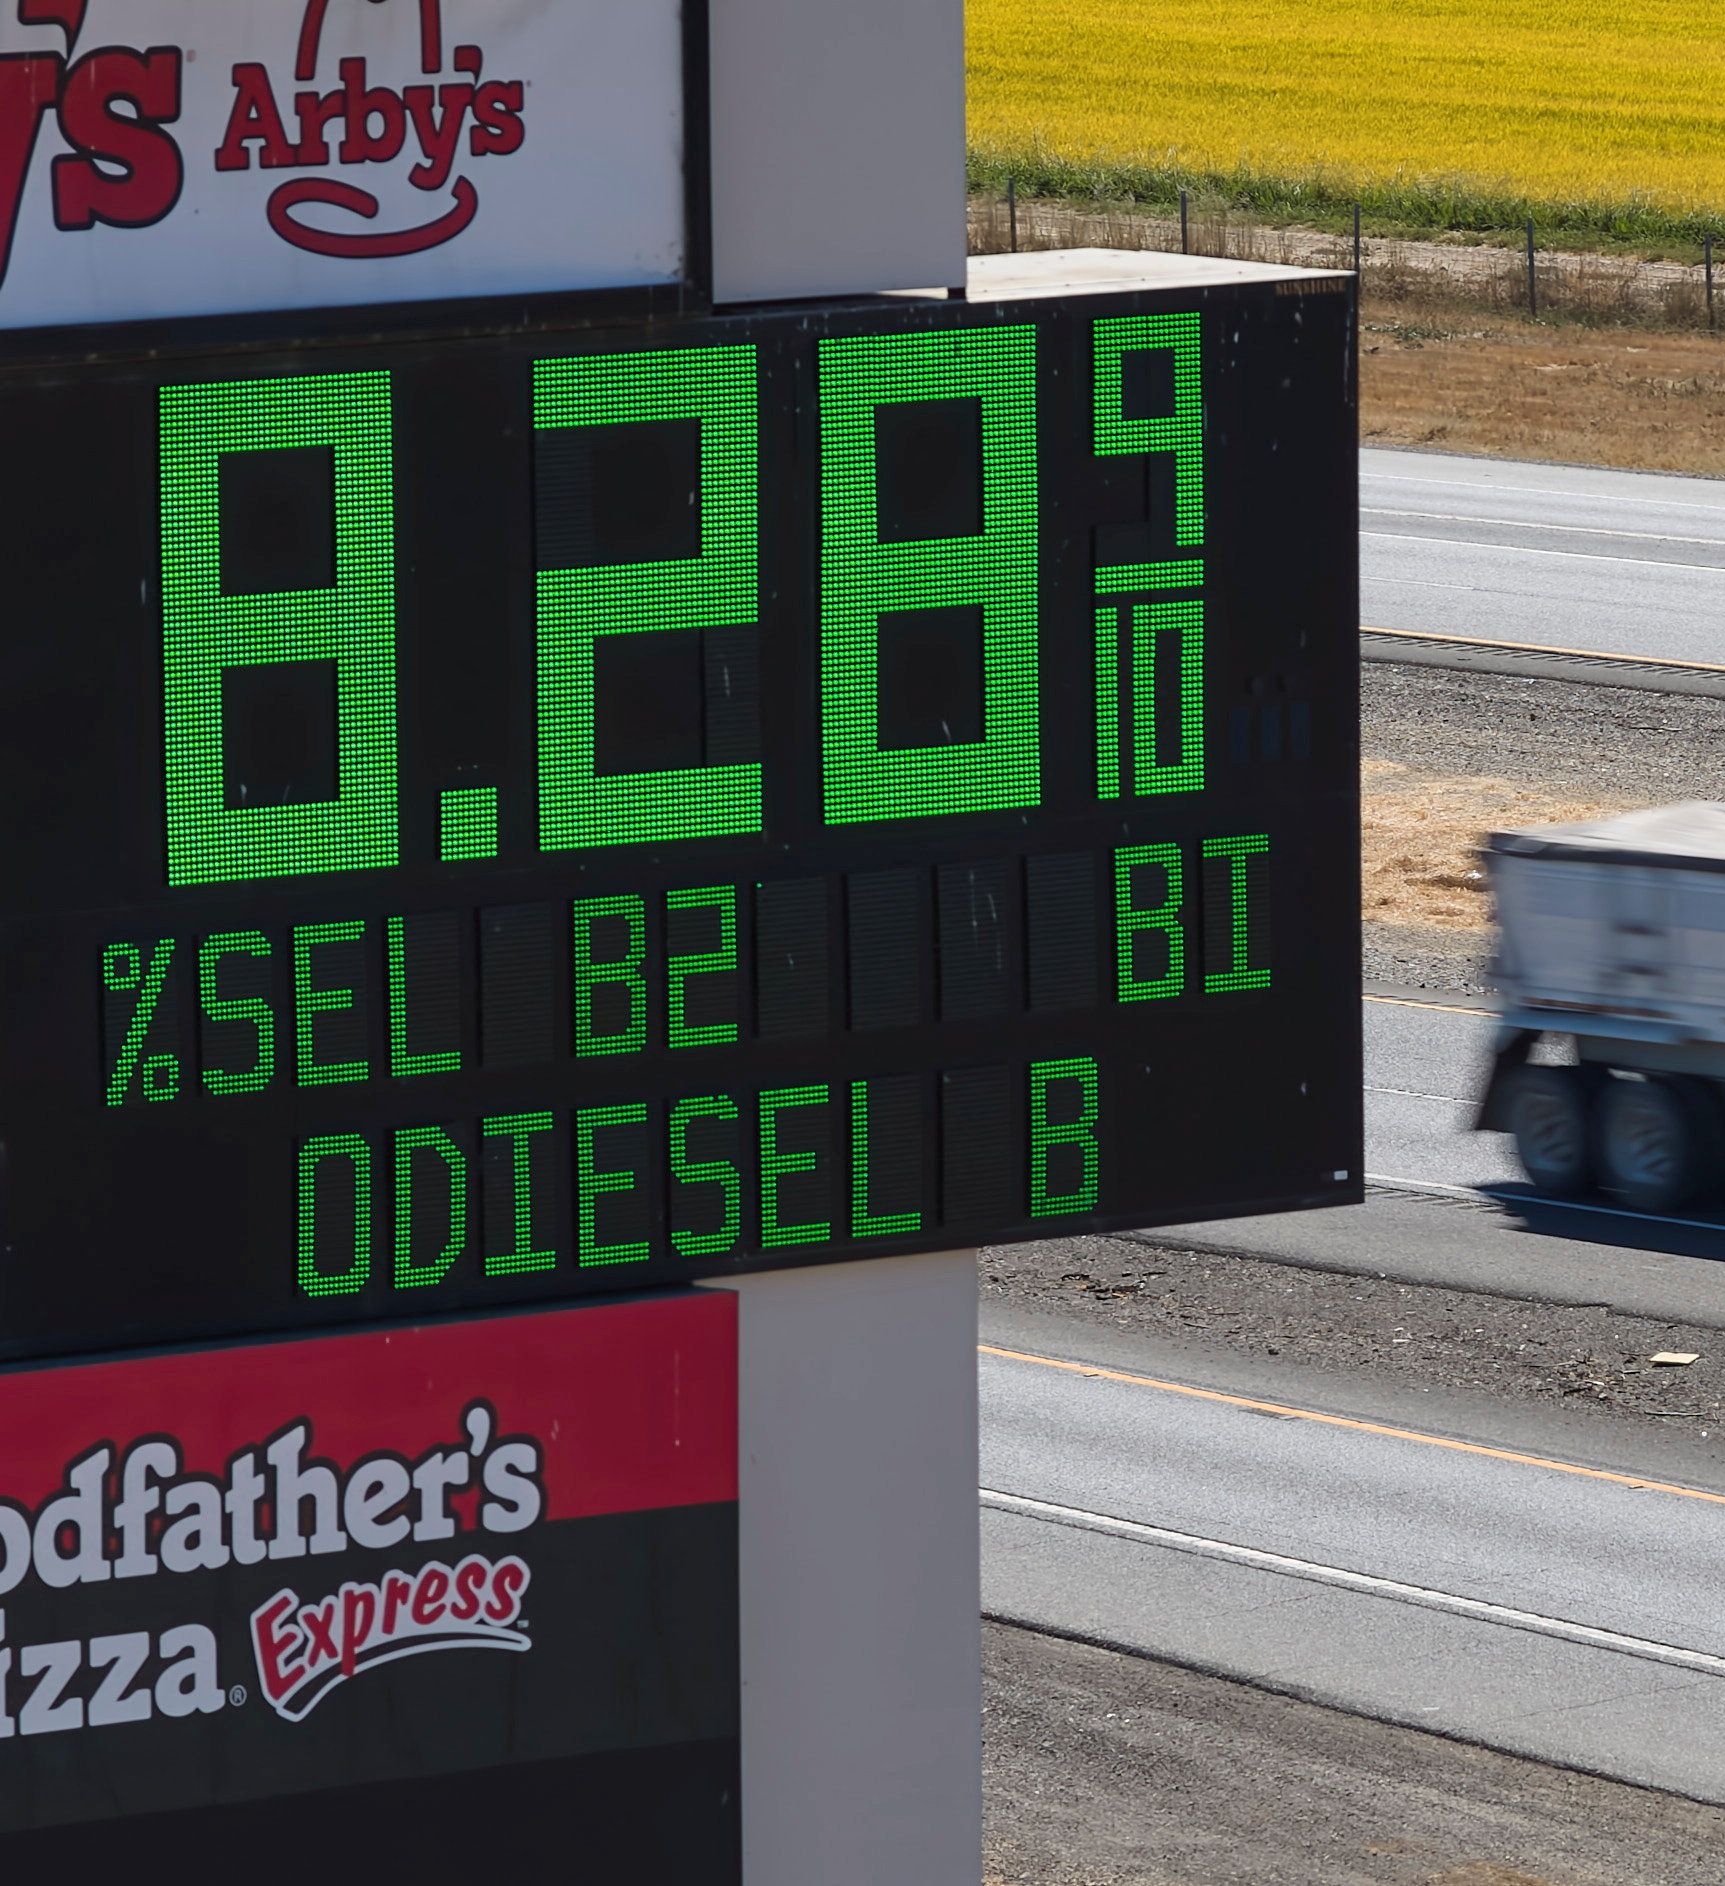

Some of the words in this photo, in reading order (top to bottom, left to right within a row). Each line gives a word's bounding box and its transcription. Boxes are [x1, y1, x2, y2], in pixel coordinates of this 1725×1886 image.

[214, 45, 526, 191] Arby's
[1093, 312, 1204, 545] 9
[1095, 600, 1204, 799] 10
[104, 917, 460, 1105] %SEL
[575, 886, 737, 1056] B2
[1115, 834, 1271, 1002] BI
[1031, 1058, 1098, 1216] B
[253, 1557, 528, 1703] Express
